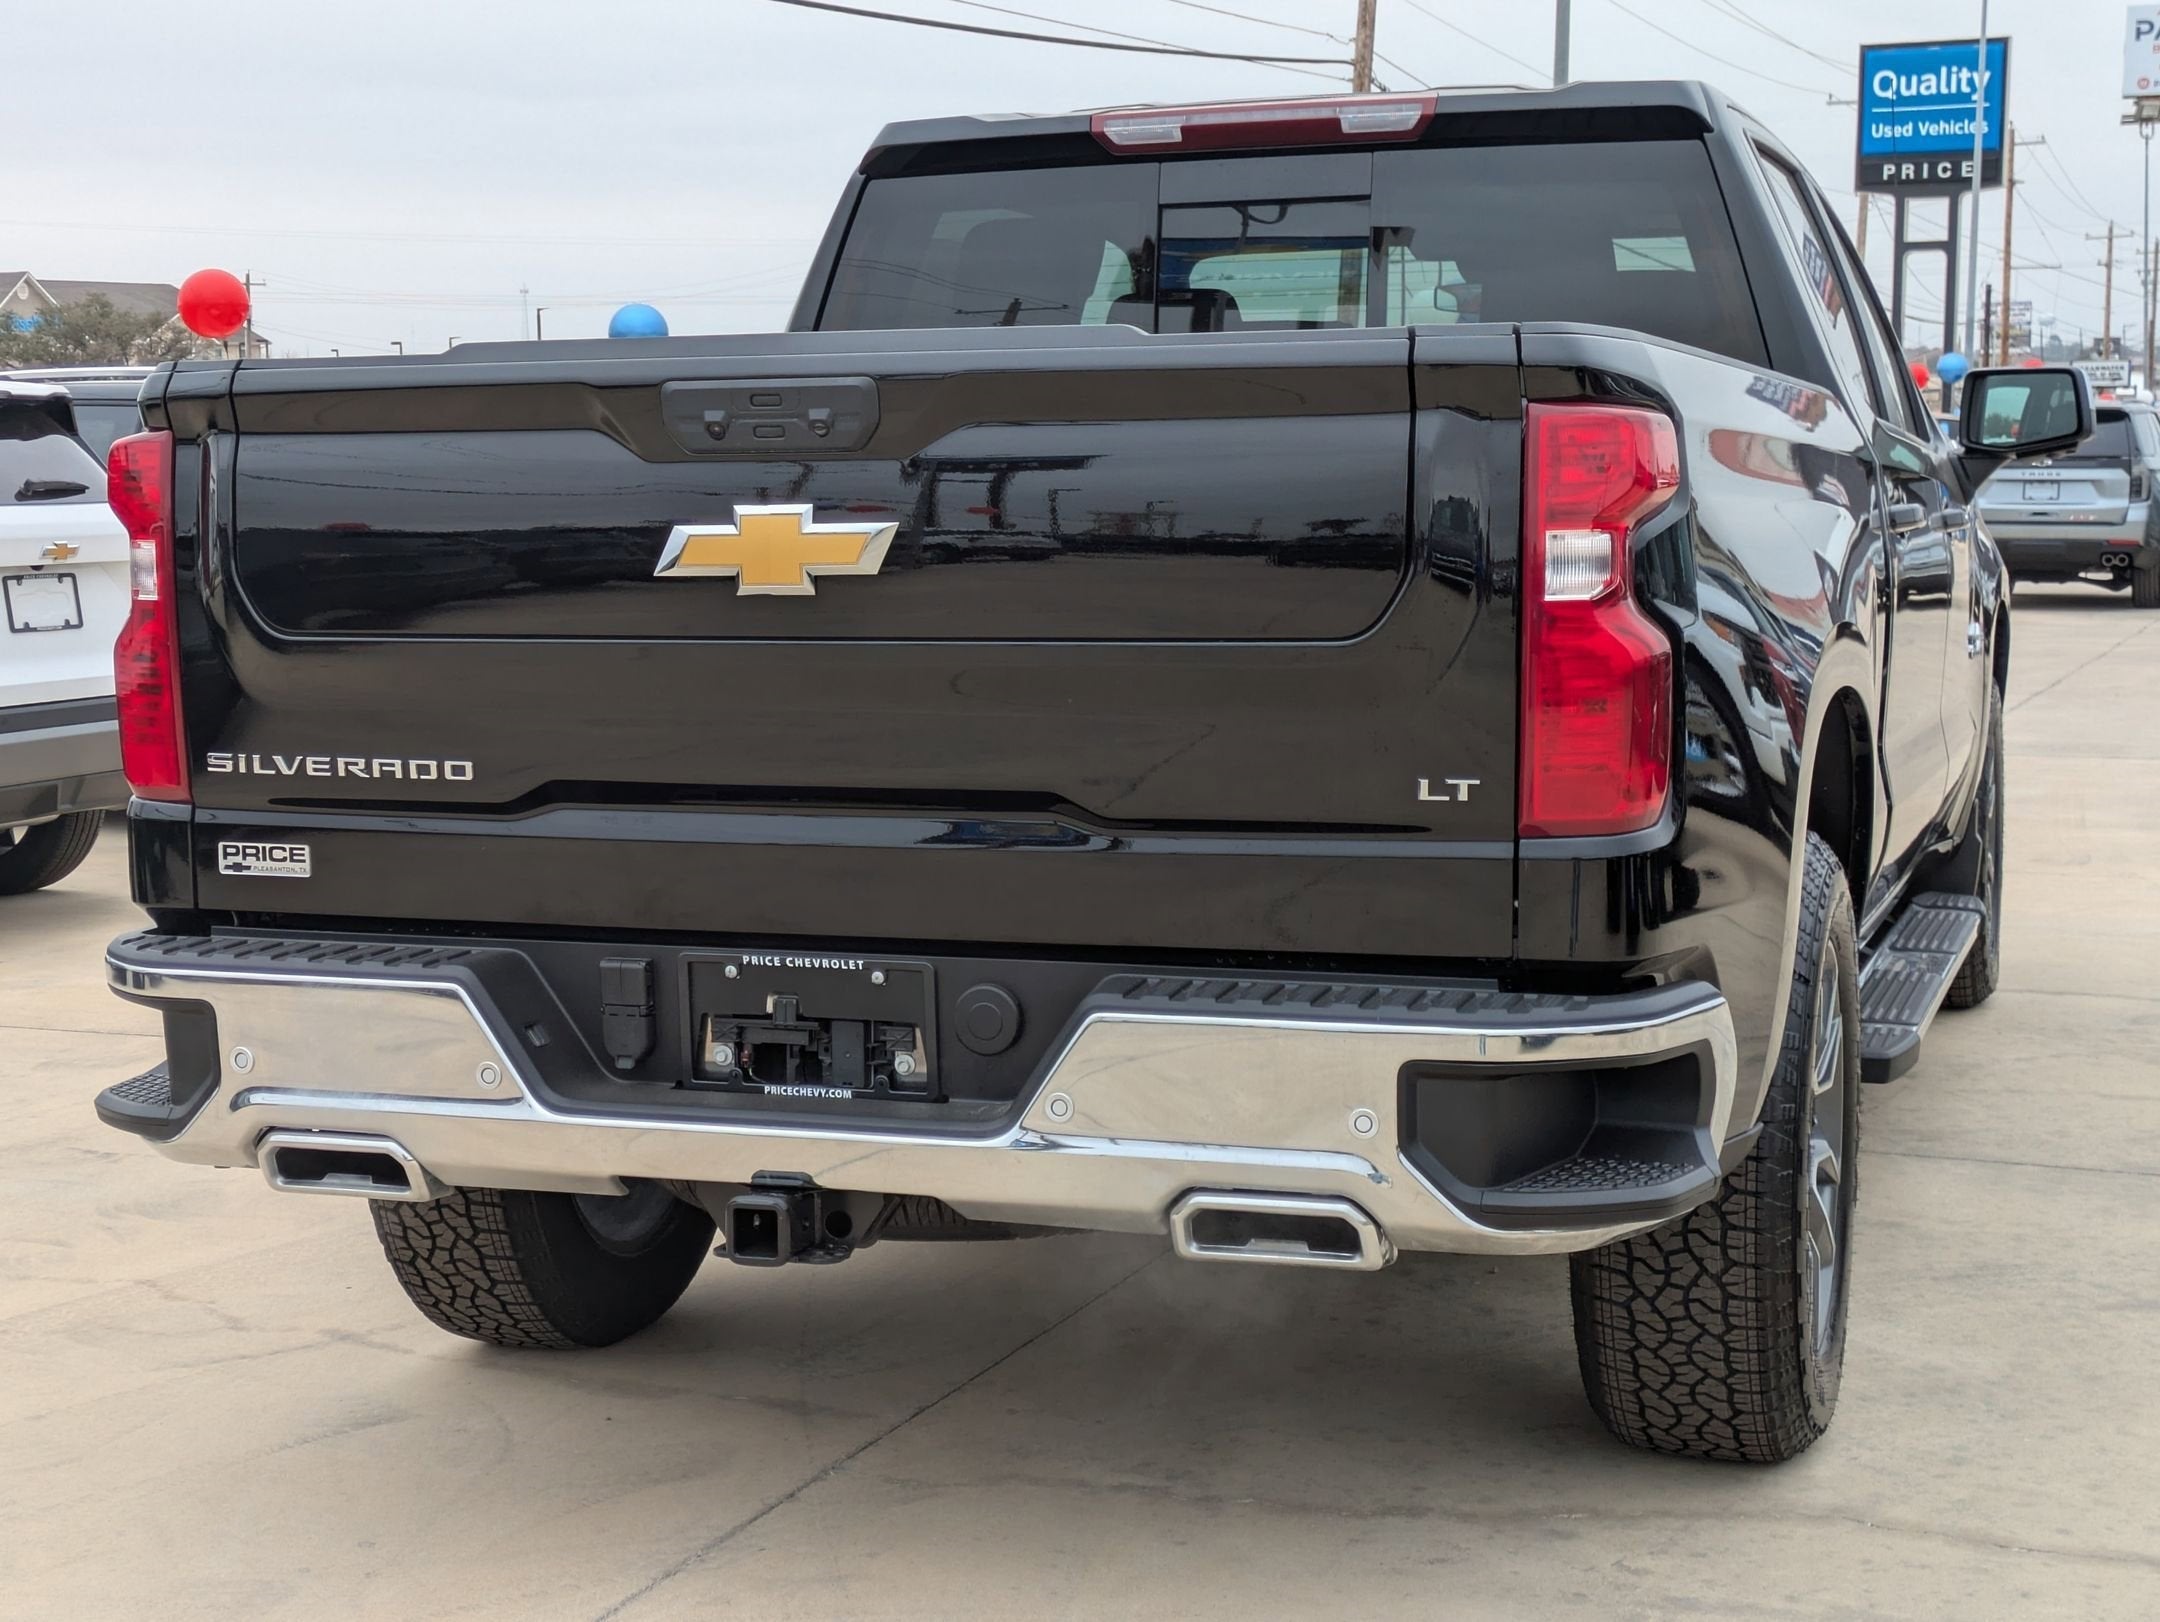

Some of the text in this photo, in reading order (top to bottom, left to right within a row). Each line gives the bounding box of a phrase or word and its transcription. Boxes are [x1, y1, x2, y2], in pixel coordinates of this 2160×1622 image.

[1872, 65, 1991, 101] Quality
[1871, 118, 1989, 138] Used Vehicles
[1882, 160, 1975, 181] PRICE
[206, 752, 474, 781] SILVERADO
[1418, 778, 1481, 801] LT
[222, 844, 307, 864] PRICE
[253, 865, 298, 874] PLEASANTON,
[742, 955, 864, 970] PRICE CHEVROLET
[764, 1085, 852, 1099] PRICECHEVY.COM
